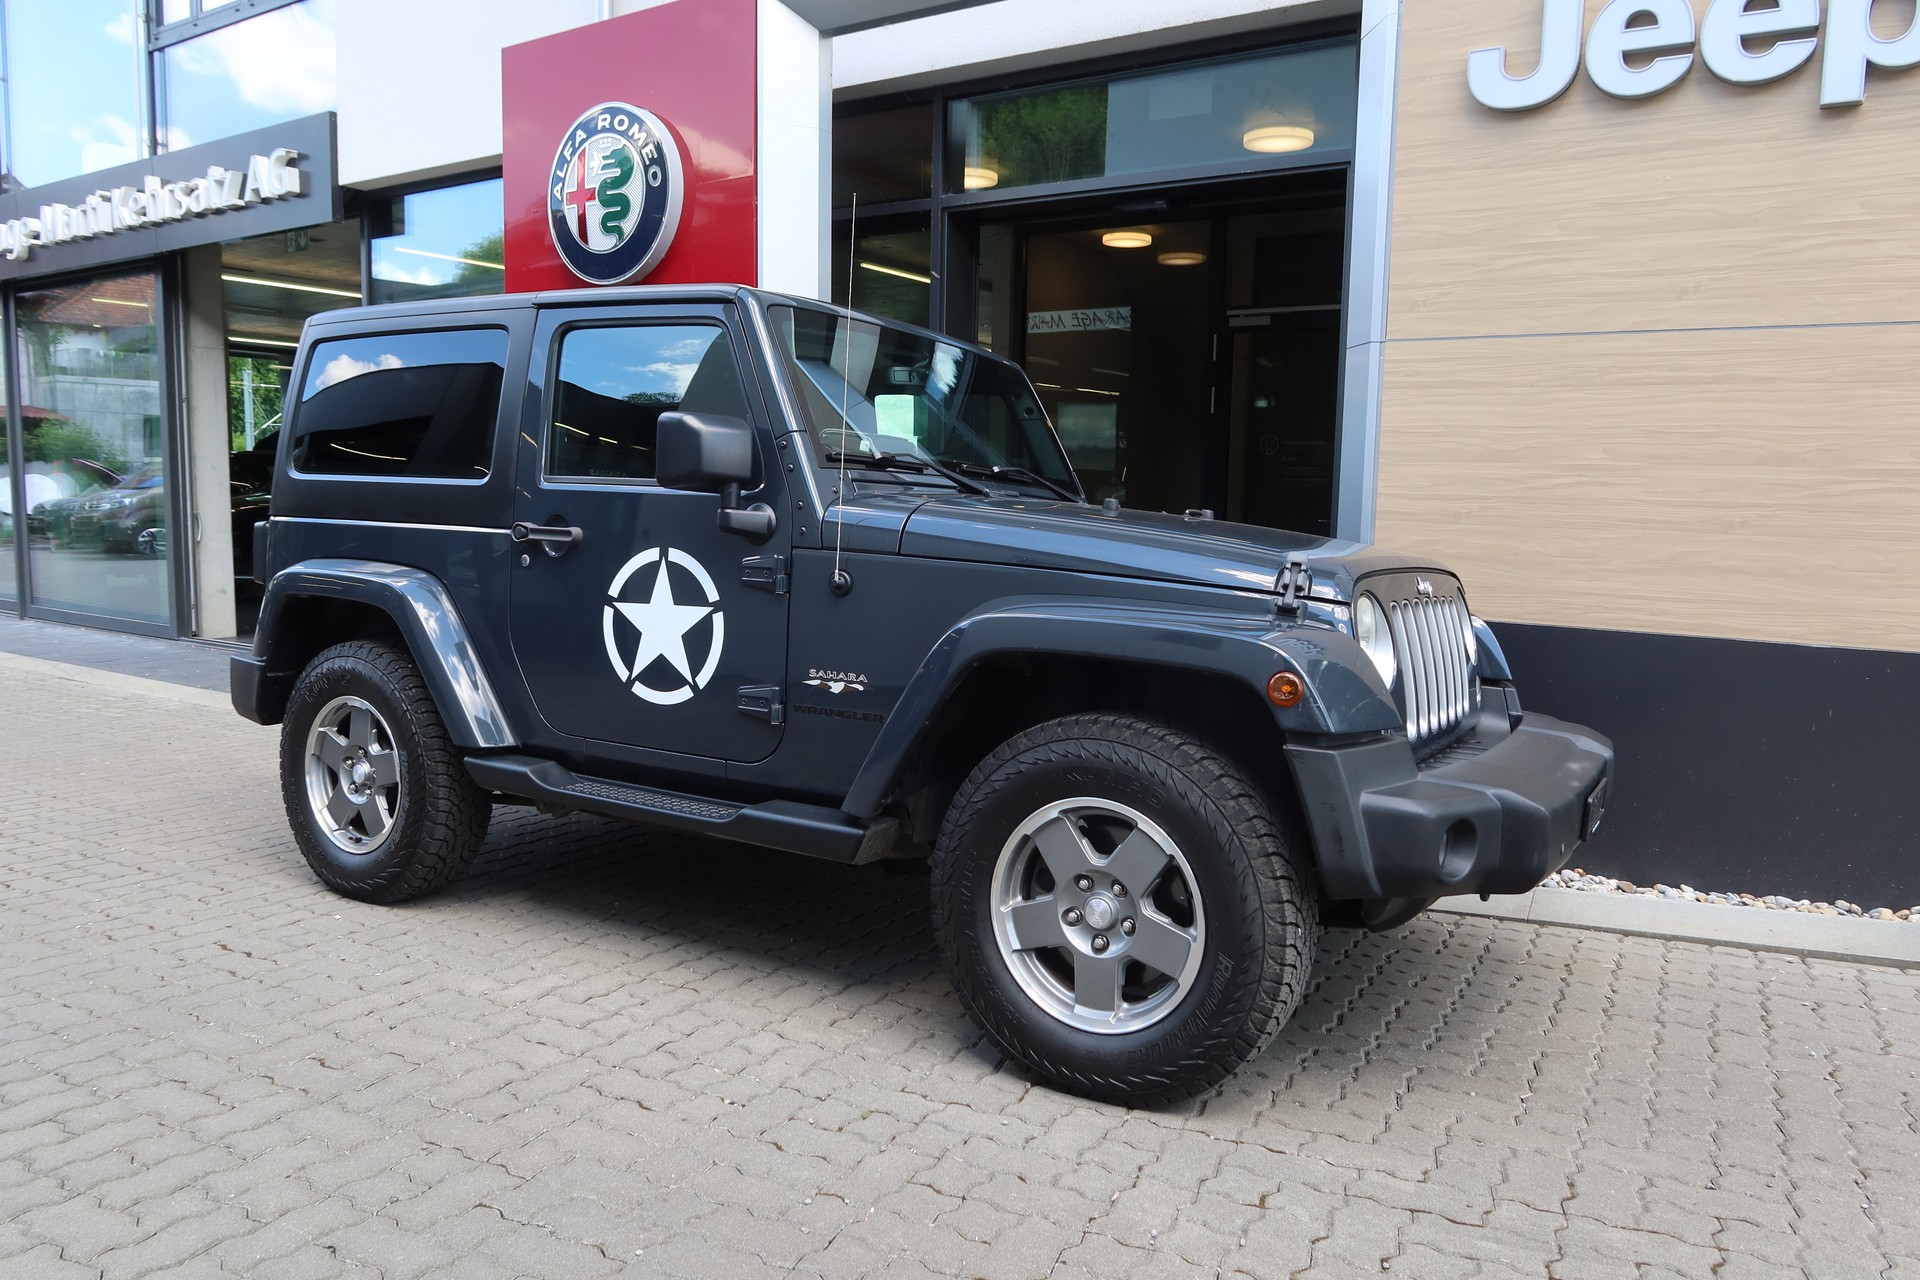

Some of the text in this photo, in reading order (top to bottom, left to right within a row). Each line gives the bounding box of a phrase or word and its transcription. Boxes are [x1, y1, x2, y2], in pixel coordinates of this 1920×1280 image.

[1467, 0, 1920, 111] Jeep
[553, 113, 662, 200] ALFA ROMEO
[111, 165, 245, 230] Kehrsatz
[244, 148, 300, 204] AG
[808, 668, 868, 683] SAHARA
[792, 703, 887, 725] WRANGLER
[1059, 764, 1167, 809] KUMHO
